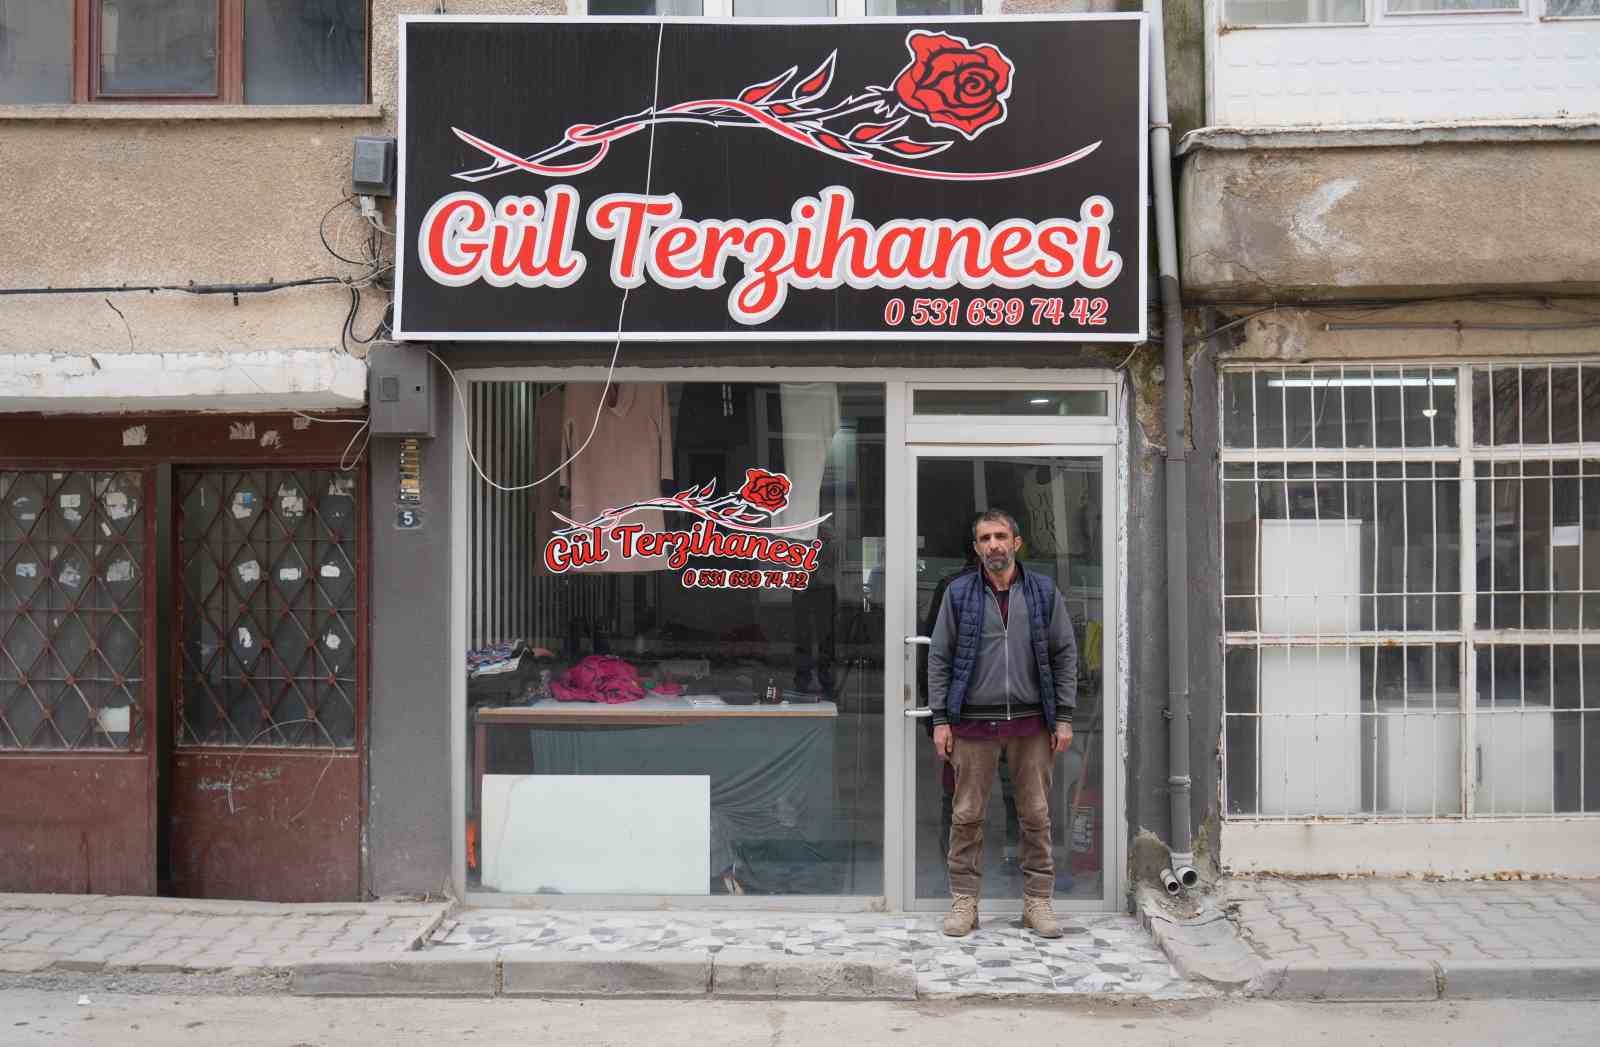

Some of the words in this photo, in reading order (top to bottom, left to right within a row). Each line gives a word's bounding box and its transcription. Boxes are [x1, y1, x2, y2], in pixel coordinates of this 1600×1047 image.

[419, 185, 586, 288] Gül
[587, 187, 1121, 324] Terzihanesi
[884, 297, 906, 326] 0
[911, 297, 960, 326] 531
[966, 297, 1025, 326] 639
[1030, 297, 1064, 326] 74
[1069, 297, 1109, 326] 42
[403, 511, 414, 526] 5
[544, 526, 609, 573] Gül
[610, 519, 821, 571] Terzihanesi
[682, 568, 697, 588] 0
[697, 569, 727, 588] 531
[727, 570, 763, 588] 639
[763, 570, 785, 589] 74
[785, 570, 810, 590] 42
